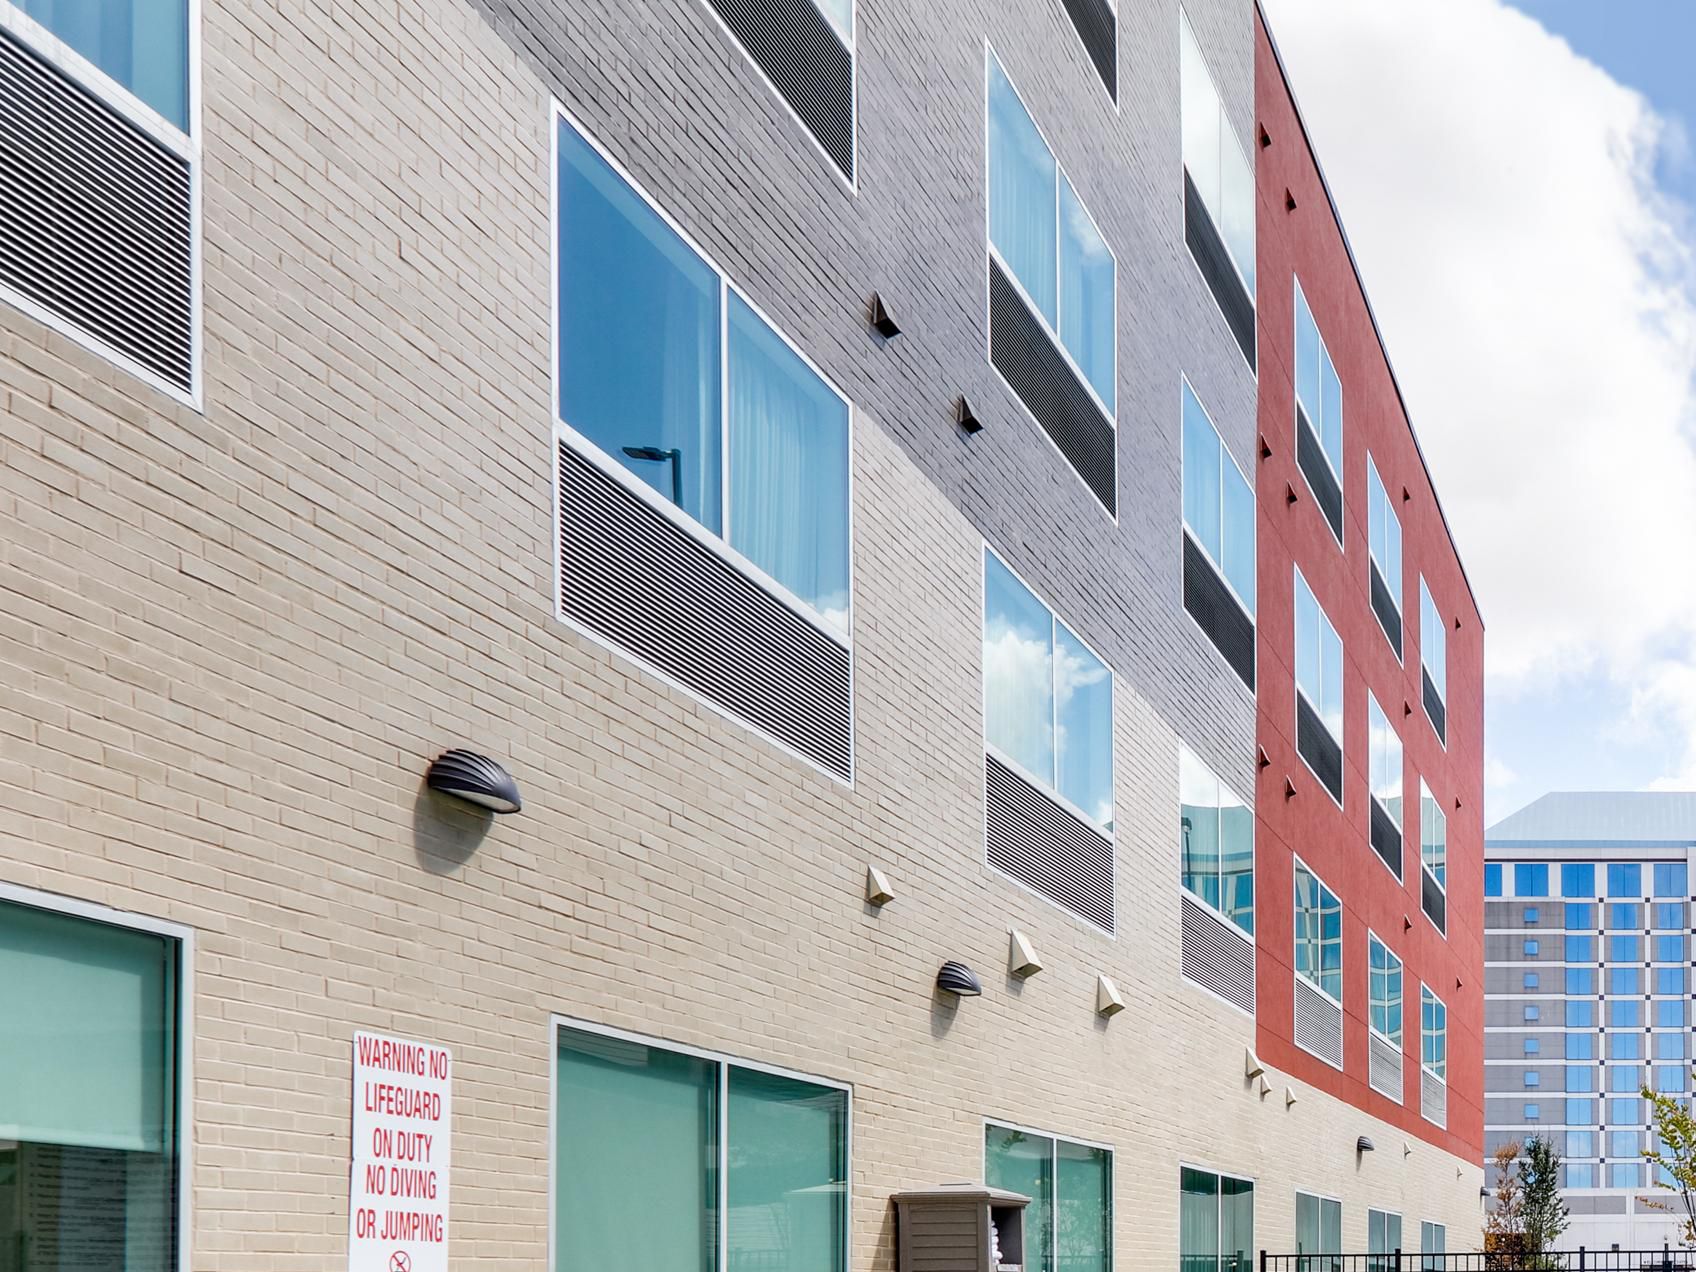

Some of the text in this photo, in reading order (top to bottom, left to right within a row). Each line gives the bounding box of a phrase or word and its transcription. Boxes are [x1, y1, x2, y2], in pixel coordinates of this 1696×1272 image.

[358, 1035, 448, 1080] WARNING NO
[365, 1081, 441, 1121] LIFEGUARD
[373, 1127, 433, 1163] ON DUTY
[366, 1164, 437, 1199] NO DIVING
[357, 1208, 443, 1242] OR JUMPING
